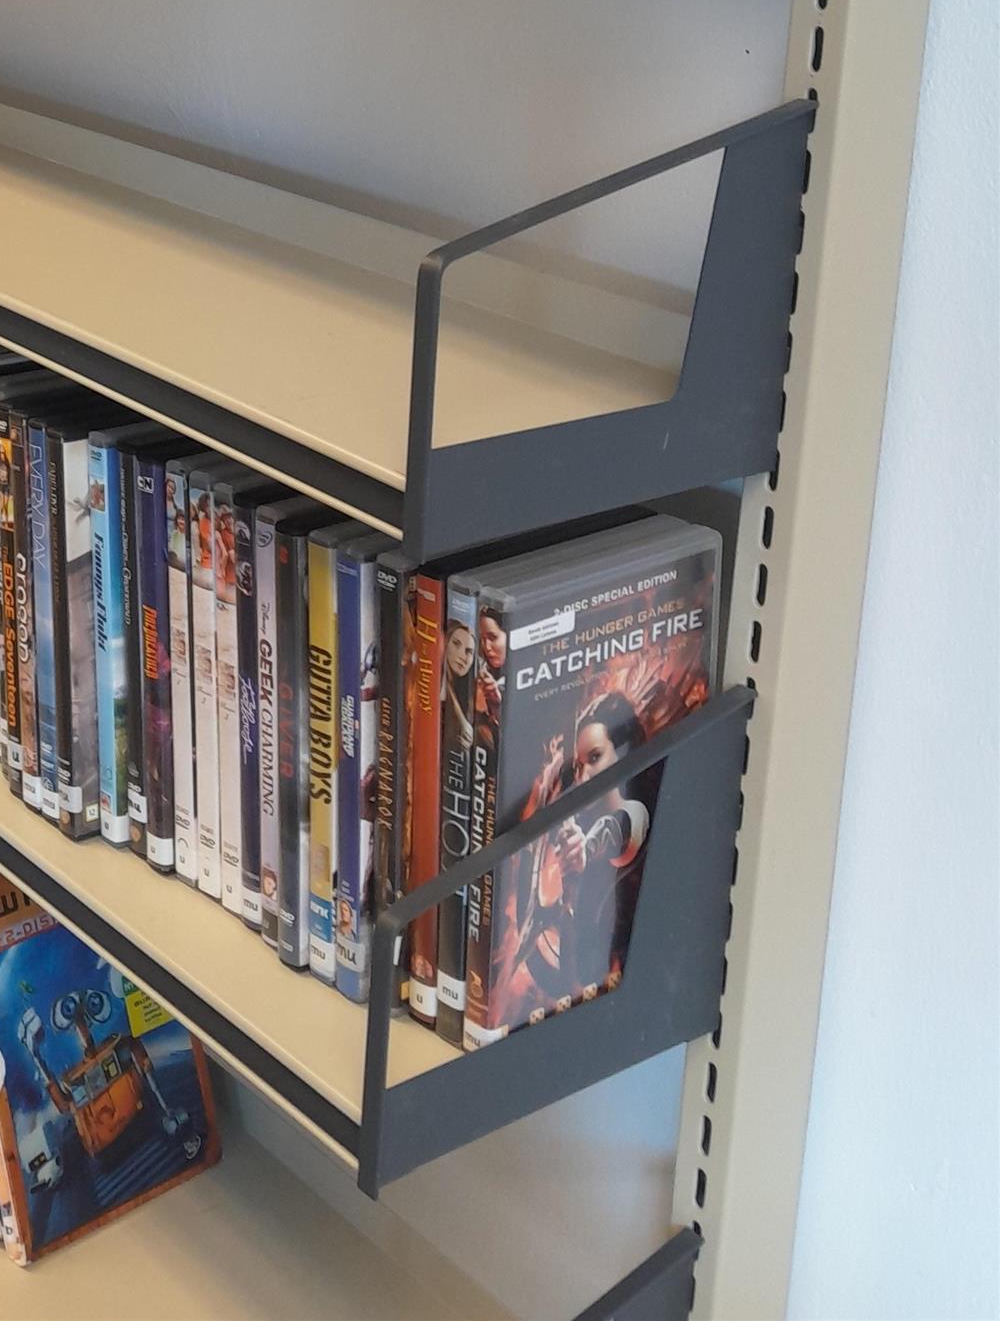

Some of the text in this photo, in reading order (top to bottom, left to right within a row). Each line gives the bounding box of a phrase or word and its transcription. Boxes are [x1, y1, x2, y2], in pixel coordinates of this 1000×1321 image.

[29, 444, 47, 570] EVERY DAY
[3, 563, 15, 623] EDGE
[16, 552, 28, 663] eragon
[377, 570, 397, 584] DVD
[591, 584, 634, 609] SPECIAL
[638, 569, 678, 592] EDITION
[516, 628, 644, 690] CATCHING
[651, 608, 704, 644] FIRE
[542, 637, 570, 656] THE
[575, 615, 633, 646] HUNGER
[637, 598, 684, 624] GAMES
[5, 628, 17, 728] Seventeen
[259, 638, 274, 702] GEEK
[238, 674, 257, 765] Footloose
[309, 644, 333, 805] GUTTA BOYS
[259, 705, 275, 816] CHARMING
[378, 732, 394, 831] RAGNAROK
[448, 748, 465, 790] THE
[468, 745, 487, 942] CATCHIN FIRE
[4, 914, 57, 944] 2-DIS
[416, 992, 423, 1006] u
[442, 984, 459, 1001] mu
